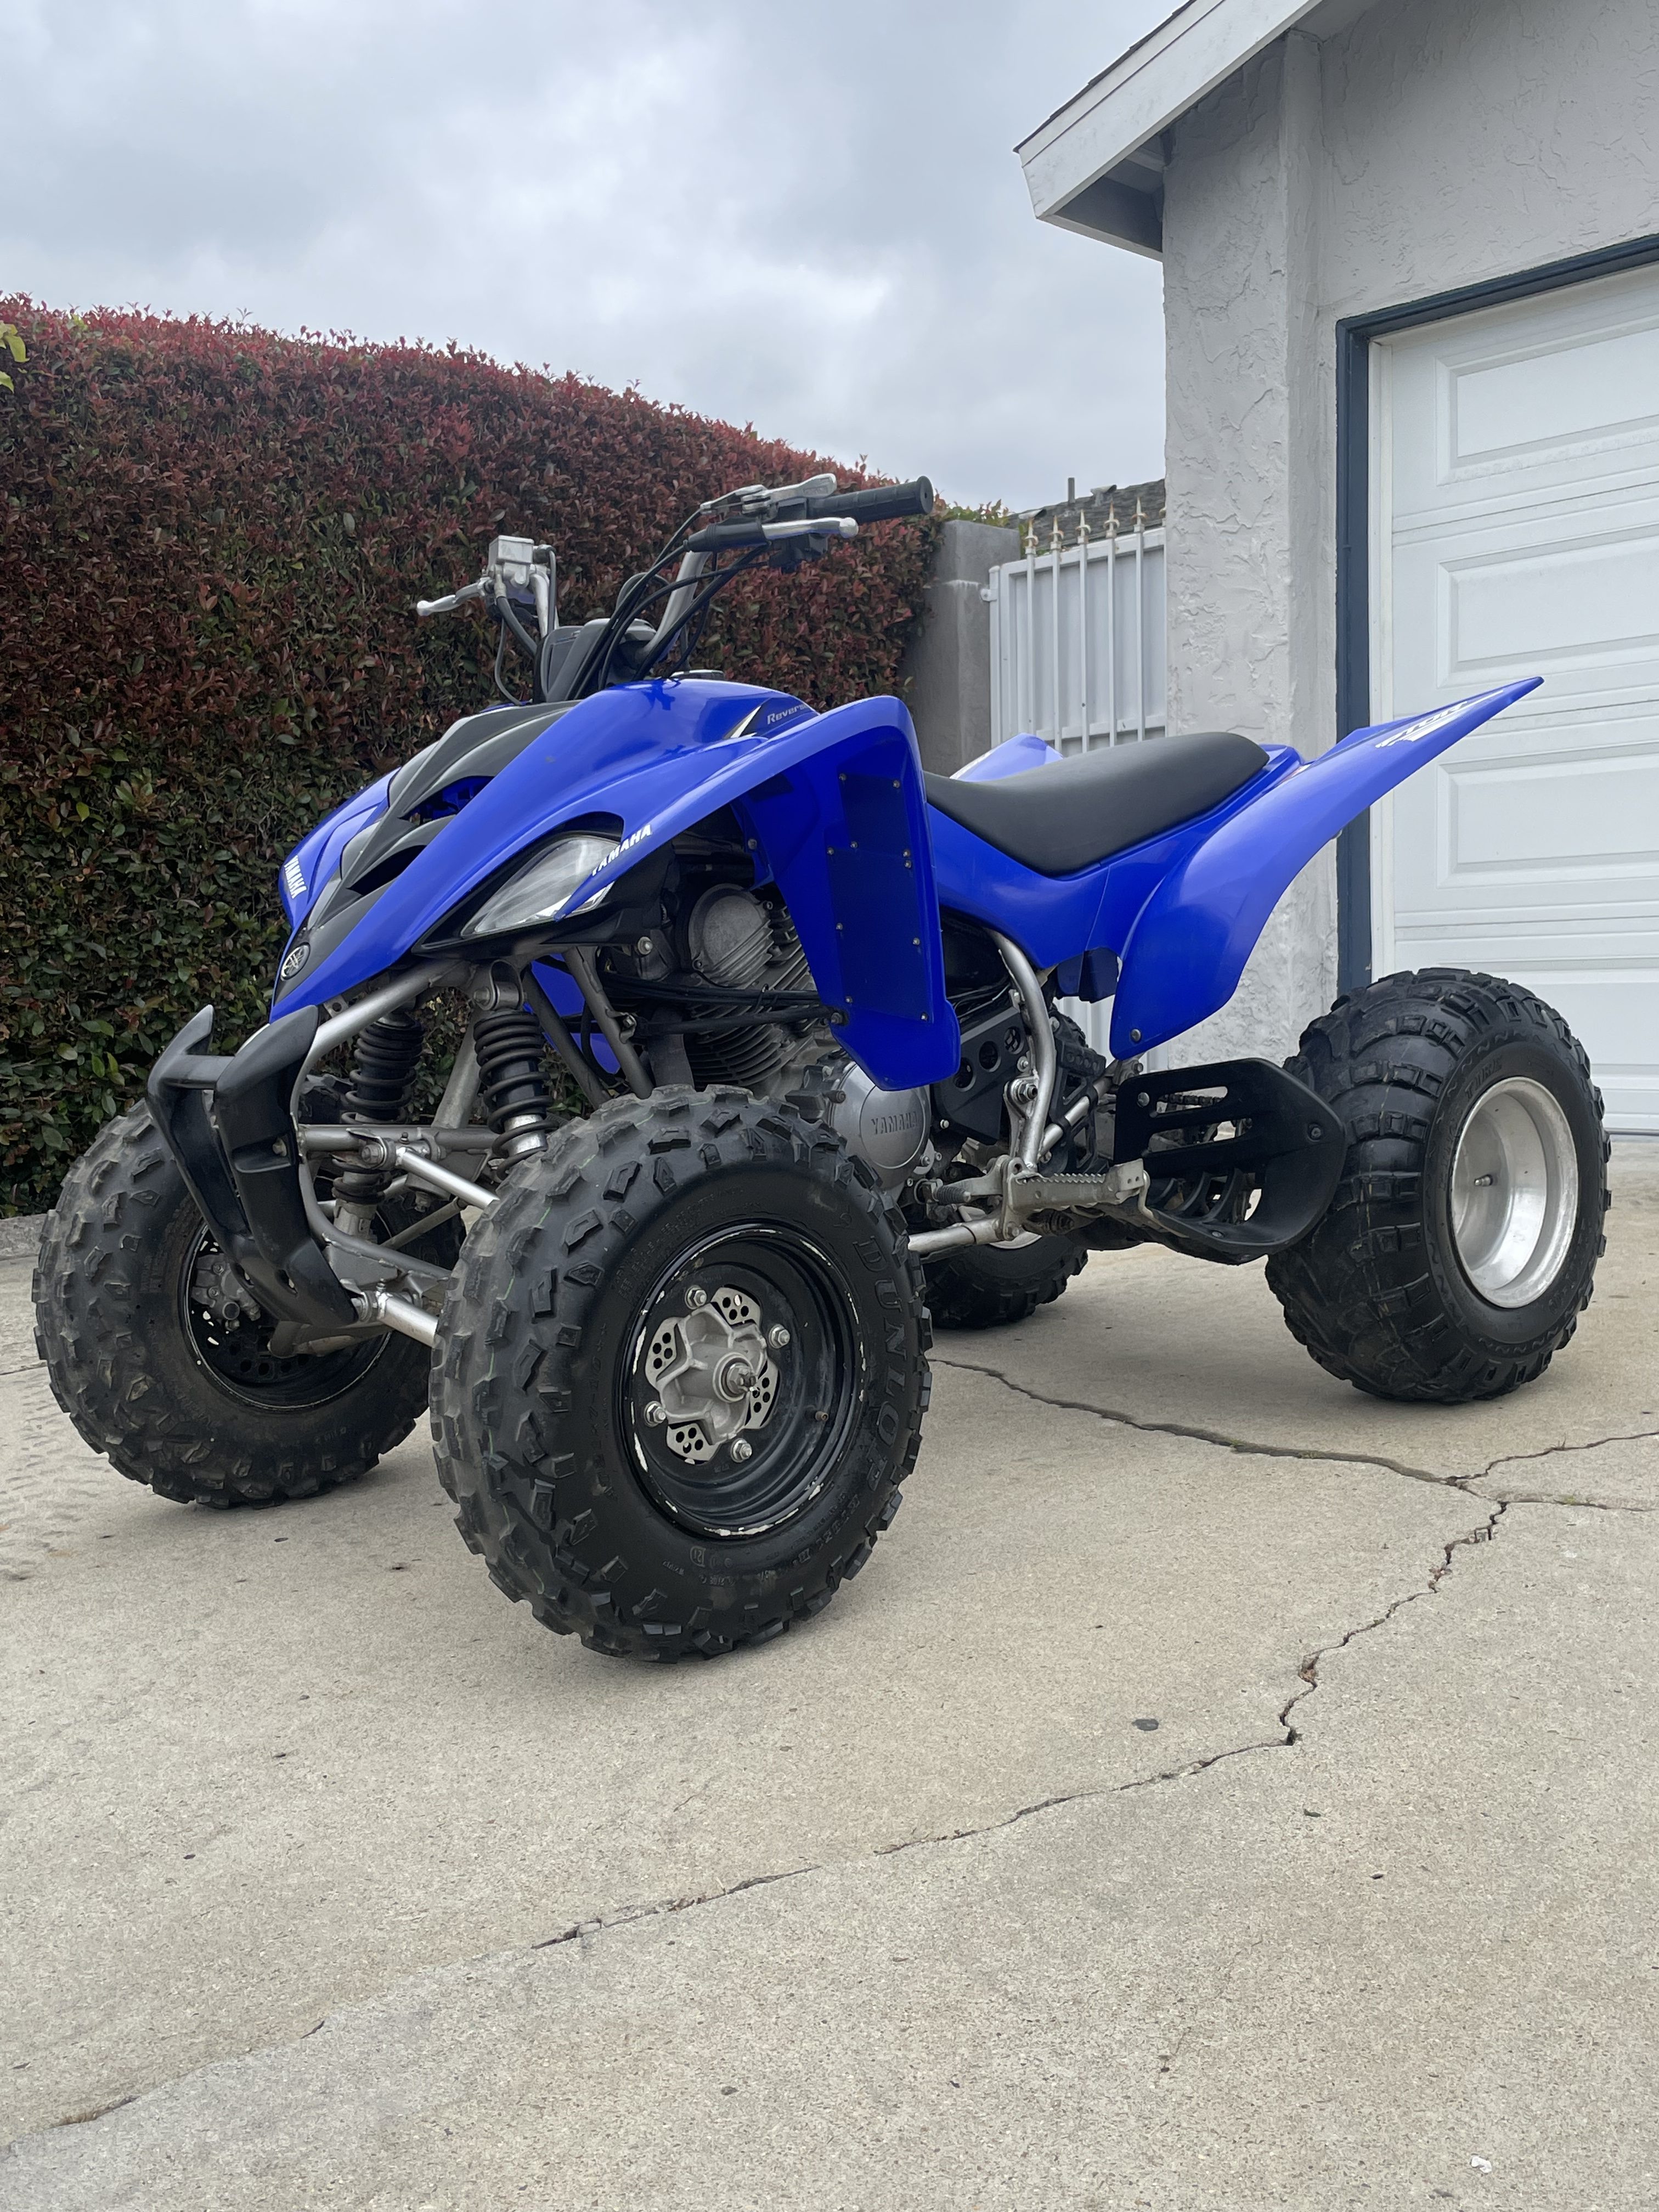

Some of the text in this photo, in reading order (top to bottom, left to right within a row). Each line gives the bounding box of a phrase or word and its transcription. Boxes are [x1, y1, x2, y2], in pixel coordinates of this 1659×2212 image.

[283, 855, 307, 899] YAMAHA
[871, 1111, 918, 1135] YAMAHA
[853, 1235, 907, 1492] DUNLOP
